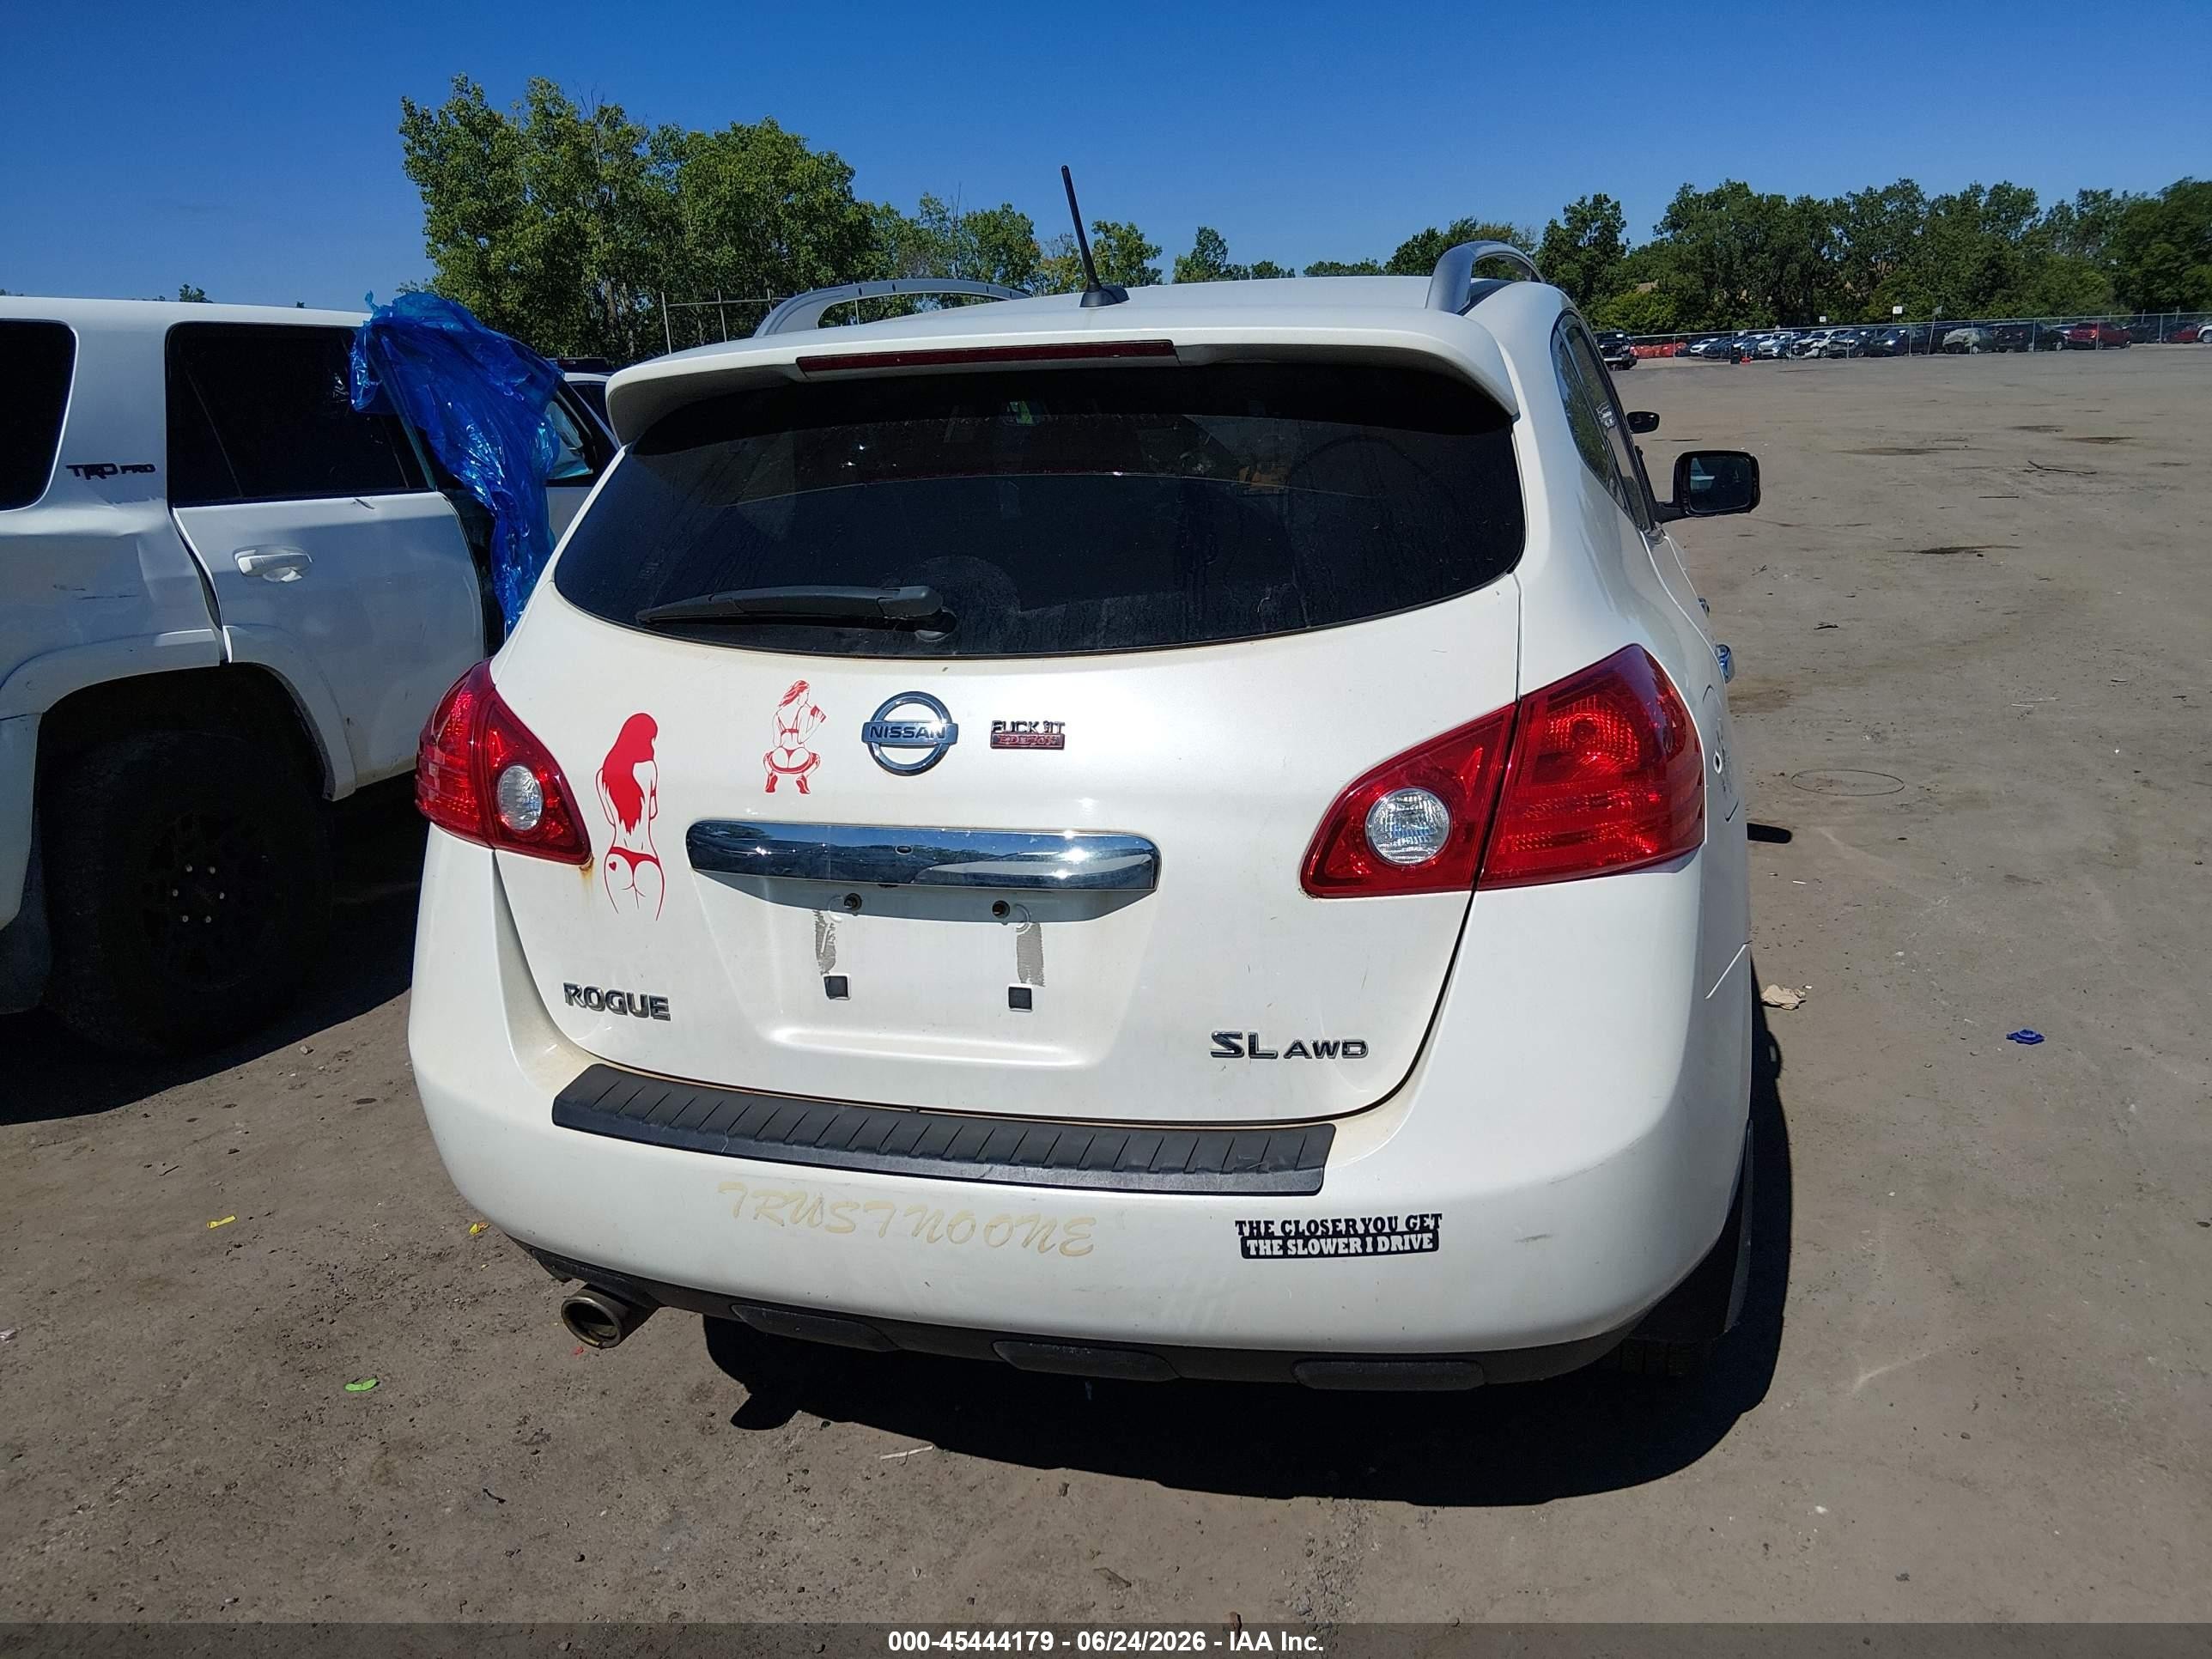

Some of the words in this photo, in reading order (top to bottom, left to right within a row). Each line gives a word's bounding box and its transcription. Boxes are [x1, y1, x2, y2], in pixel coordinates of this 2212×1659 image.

[65, 463, 117, 480] TRD
[119, 464, 156, 474] PRO
[869, 724, 945, 738] NISSAN
[563, 982, 672, 1021] ROGUE
[1210, 1030, 1278, 1059] SL
[1284, 1039, 1369, 1059] AWD
[1235, 1220, 1274, 1237] THE
[1280, 1218, 1360, 1236] CLOSER
[1360, 1216, 1398, 1234] YOU
[1405, 1213, 1443, 1231] GET
[1247, 1239, 1283, 1255] THE
[1286, 1237, 1363, 1255] SLOWER
[1365, 1237, 1374, 1253] I
[1376, 1233, 1433, 1252] DRIVE
